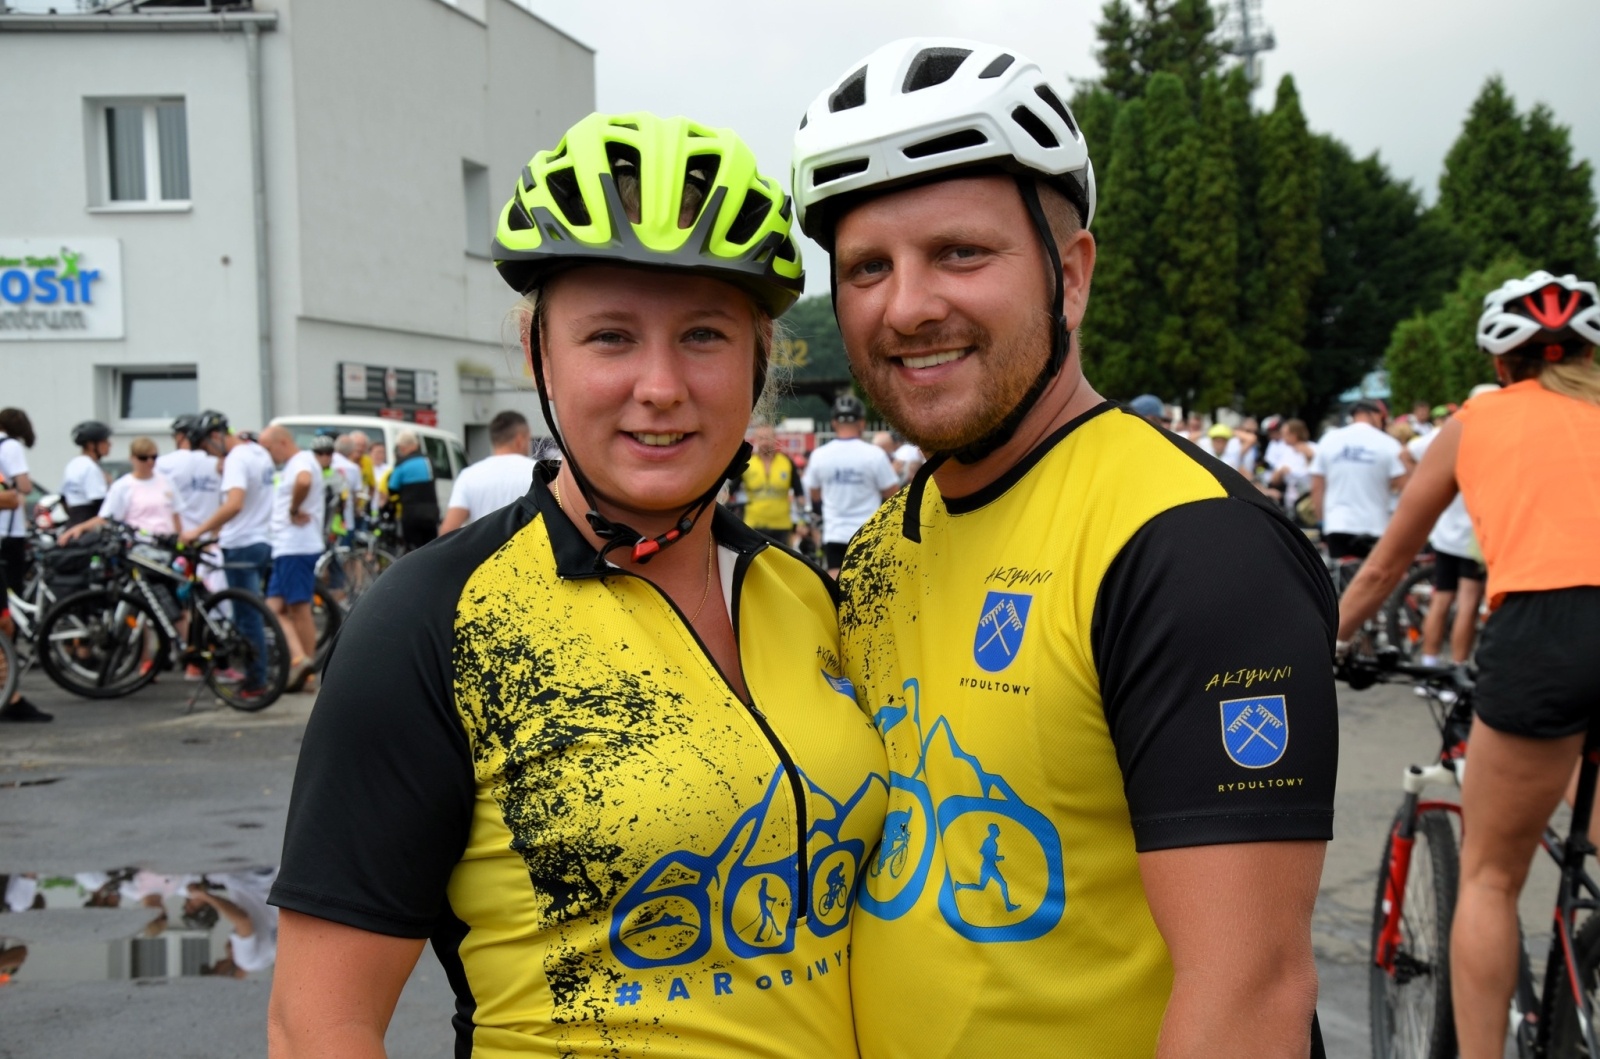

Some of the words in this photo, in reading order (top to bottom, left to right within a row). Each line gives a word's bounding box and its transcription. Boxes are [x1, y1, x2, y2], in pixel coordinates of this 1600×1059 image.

[984, 566, 1053, 588] AKTYWNI
[960, 677, 1031, 696] RYDUŁTOWY
[1205, 665, 1292, 692] AKTYWNI
[1218, 778, 1304, 793] RYDUŁTOWY
